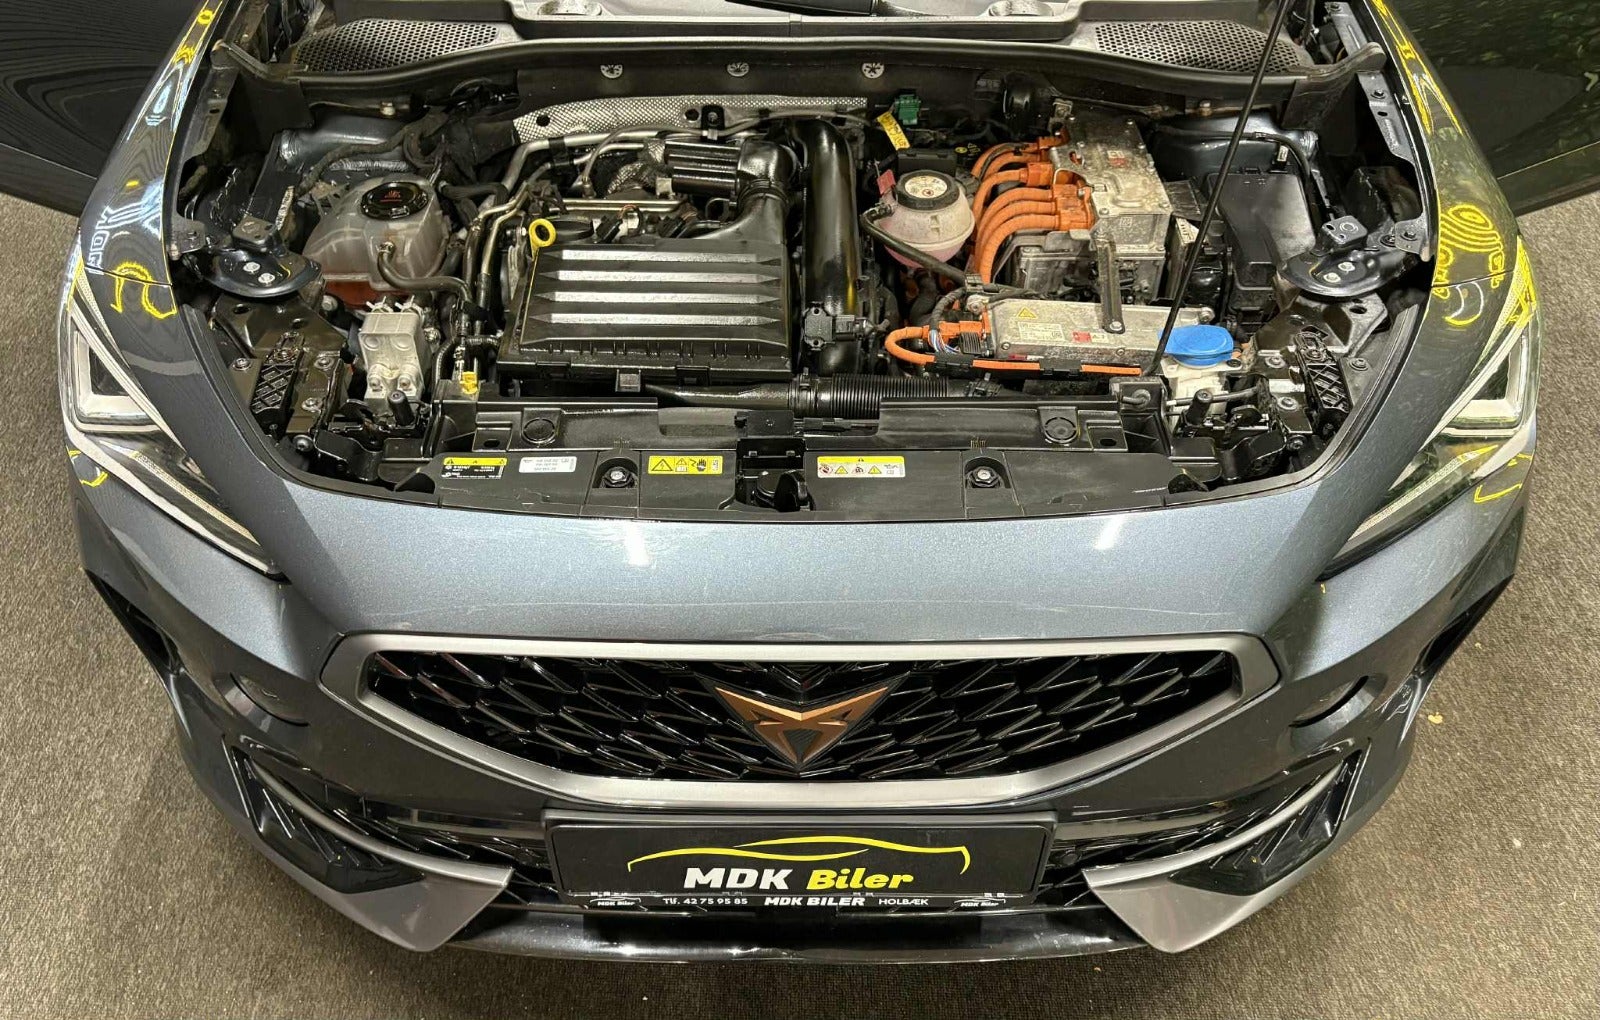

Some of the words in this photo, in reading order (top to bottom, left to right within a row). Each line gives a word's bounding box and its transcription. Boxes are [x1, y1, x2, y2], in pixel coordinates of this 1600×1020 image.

[683, 867, 793, 889] MDK
[806, 867, 914, 889] Biler
[682, 897, 698, 905] 42
[699, 897, 715, 905] 75
[716, 897, 732, 905] 95
[733, 897, 748, 905] 85
[763, 896, 803, 906] MDK
[806, 896, 866, 906] BILER
[878, 898, 929, 906] HOLBÆK
